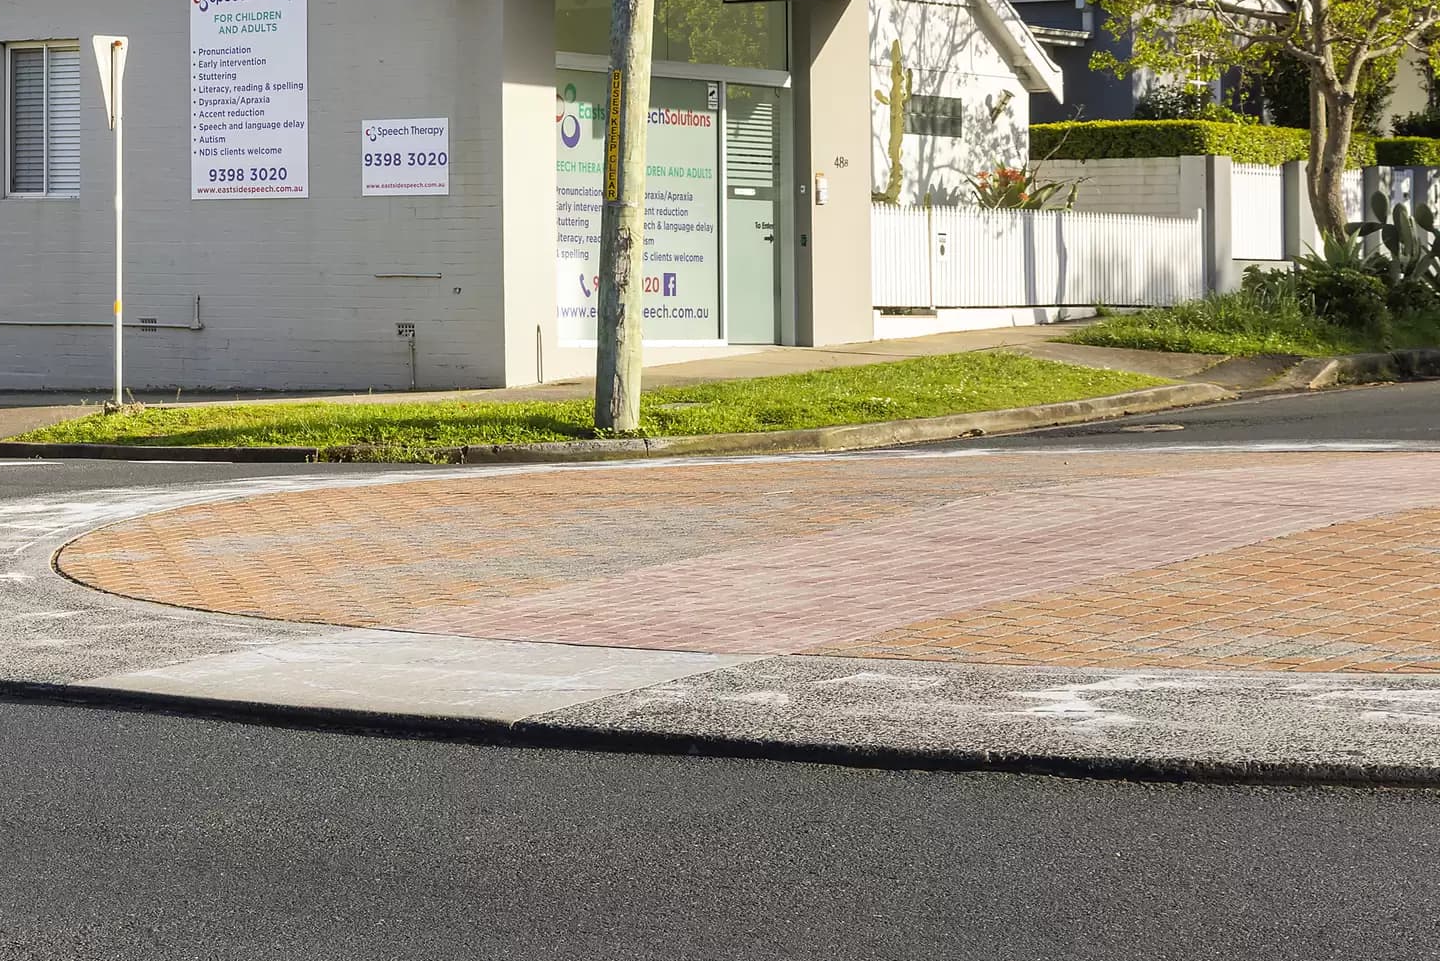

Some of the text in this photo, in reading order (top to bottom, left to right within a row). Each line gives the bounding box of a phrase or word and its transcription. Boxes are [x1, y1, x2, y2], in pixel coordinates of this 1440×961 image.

[214, 10, 282, 23] FOR CHILDREN
[218, 23, 278, 35] AND ADULTS
[198, 46, 252, 56] Pronunciation
[198, 57, 267, 69] Early intervention
[198, 72, 237, 81] Stuttering
[198, 82, 304, 94] Literacy, reading & spelling
[199, 96, 270, 107] Dyspraxia/Apraxia
[199, 108, 265, 118] Accent reduction
[199, 120, 305, 132] Speech and language delay
[377, 126, 444, 137] Speech Therapy
[199, 136, 226, 144] Autism
[608, 72, 621, 198] BUSES KEEP CLEAR
[200, 146, 282, 156] NDIS clients welcome
[364, 152, 448, 166] 9398 3020
[209, 167, 288, 182] 9398 3020
[556, 160, 576, 172] EECH
[578, 161, 603, 174] THERA
[669, 167, 684, 177] AND
[687, 168, 712, 179] ADULTS
[197, 185, 303, 194] www.eastsidespeech.com.au
[657, 207, 688, 217] reduction
[557, 217, 589, 228] tuttering
[664, 221, 694, 232] language
[696, 222, 713, 233] delay
[561, 249, 589, 261] spelling
[650, 251, 672, 262] clients
[674, 253, 704, 263] welcome
